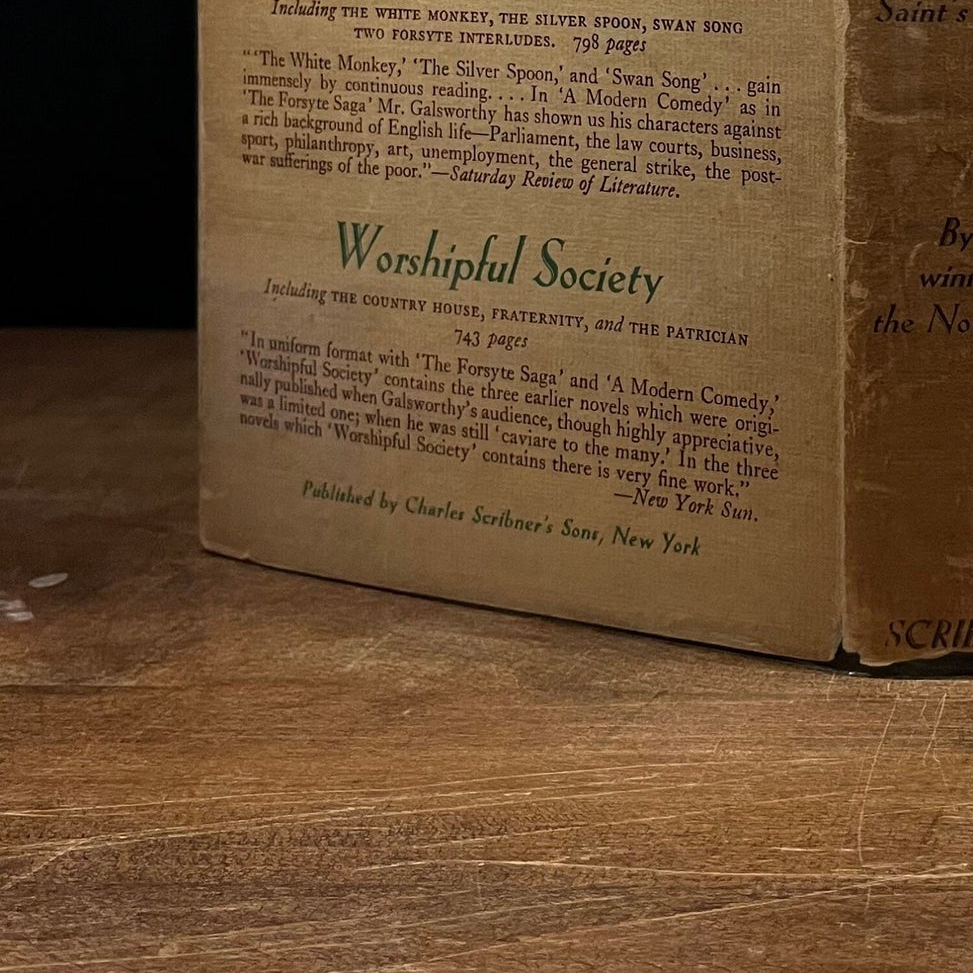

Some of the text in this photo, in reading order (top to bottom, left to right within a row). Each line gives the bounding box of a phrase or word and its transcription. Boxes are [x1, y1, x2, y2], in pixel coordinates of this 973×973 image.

[271, 0, 742, 34] Including THE WHITE MONKEY, THE SILVER SPOON, SWAN SONG
[354, 28, 646, 56] TWO FORSYTE INTERLUDES. 798 pages
[279, 91, 329, 117] Forsyte
[378, 98, 404, 115] Mr.
[411, 98, 496, 125] Galsworthy
[504, 105, 529, 123] has
[535, 107, 581, 126] shown
[588, 116, 604, 127] us
[610, 111, 631, 129] his
[638, 111, 718, 135] characters
[724, 120, 781, 144] against
[242, 154, 265, 165] war
[270, 151, 332, 175] sufferings
[338, 157, 353, 173] of
[358, 155, 379, 175] the
[522, 170, 573, 189] Review
[579, 175, 595, 195] of
[600, 176, 679, 198] Literature.
[939, 217, 973, 251] By
[337, 221, 664, 304] Worshipful Society
[264, 278, 748, 346] Including THE COUNTRY HOUSE, FRATERNITY, and THE PATRICIAN
[874, 304, 914, 334] the
[455, 329, 528, 351] 743 pages
[302, 480, 375, 507] Published
[380, 491, 398, 514] by
[406, 496, 464, 521] Charles
[561, 519, 603, 546] Sons,
[612, 526, 654, 549] New
[663, 533, 700, 555] York
[675, 493, 713, 515] York
[721, 501, 757, 522] Sun.
